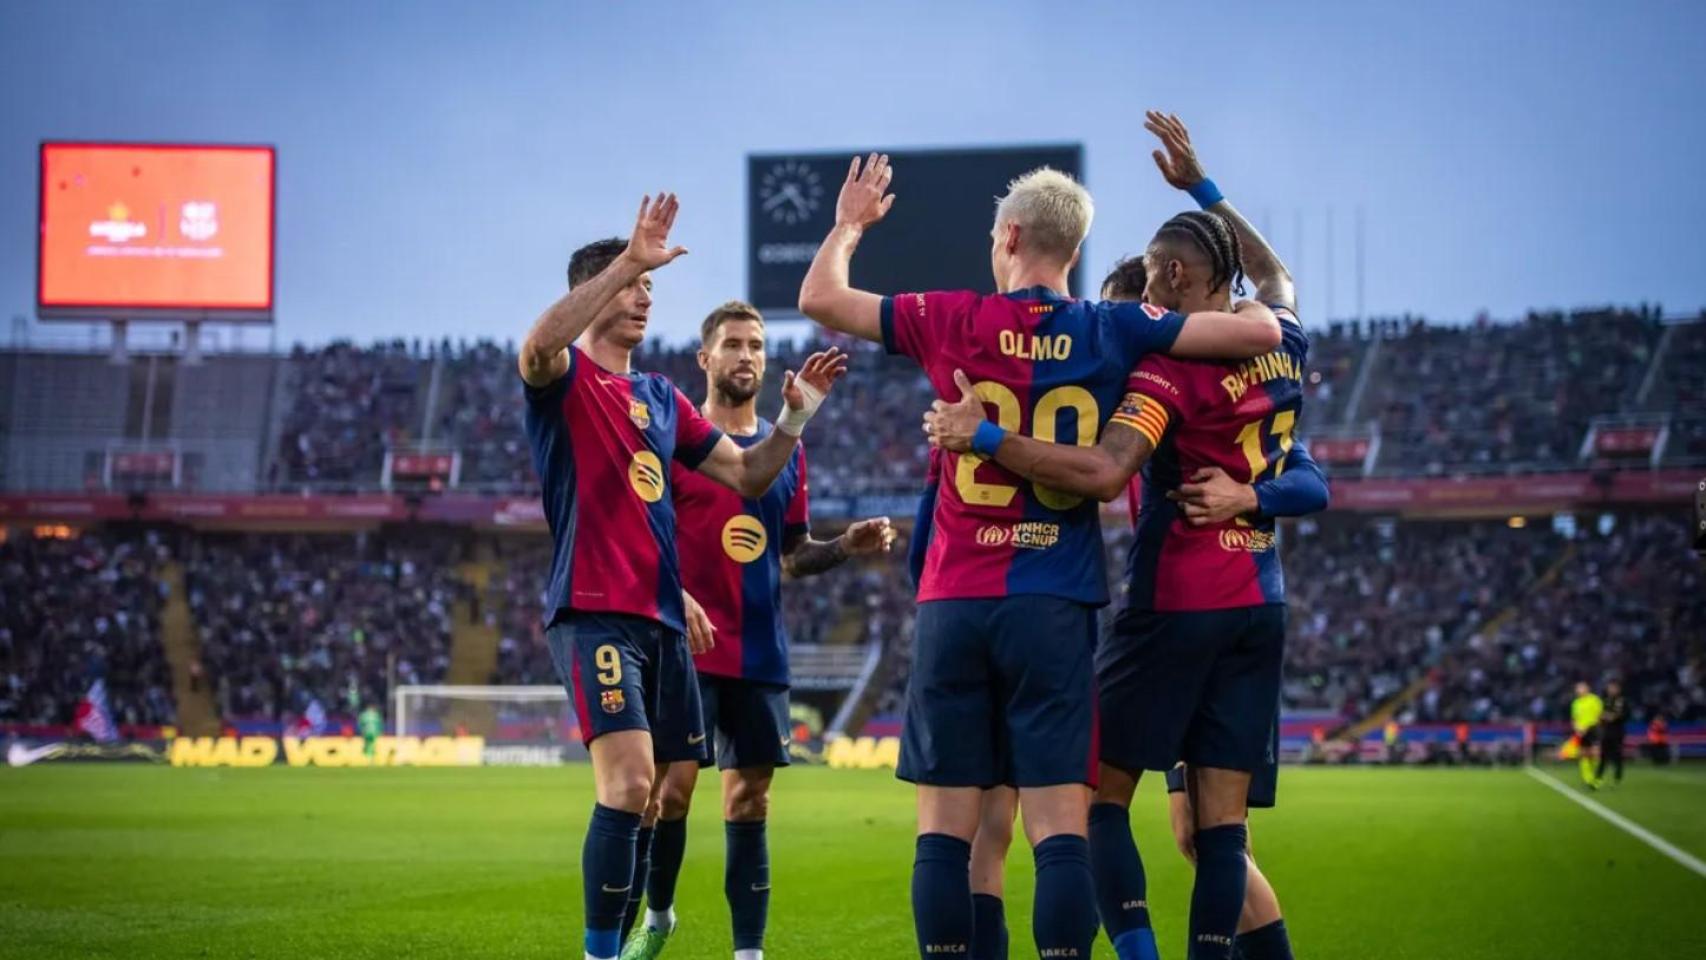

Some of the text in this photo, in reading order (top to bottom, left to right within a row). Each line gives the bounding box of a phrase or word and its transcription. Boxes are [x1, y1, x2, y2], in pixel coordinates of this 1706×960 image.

[1000, 330, 1072, 361] OLMO
[955, 381, 1099, 510] 20
[1012, 522, 1060, 536] UNHCR
[595, 644, 622, 686] 9
[170, 736, 278, 767] MAD
[826, 736, 900, 768] MA
